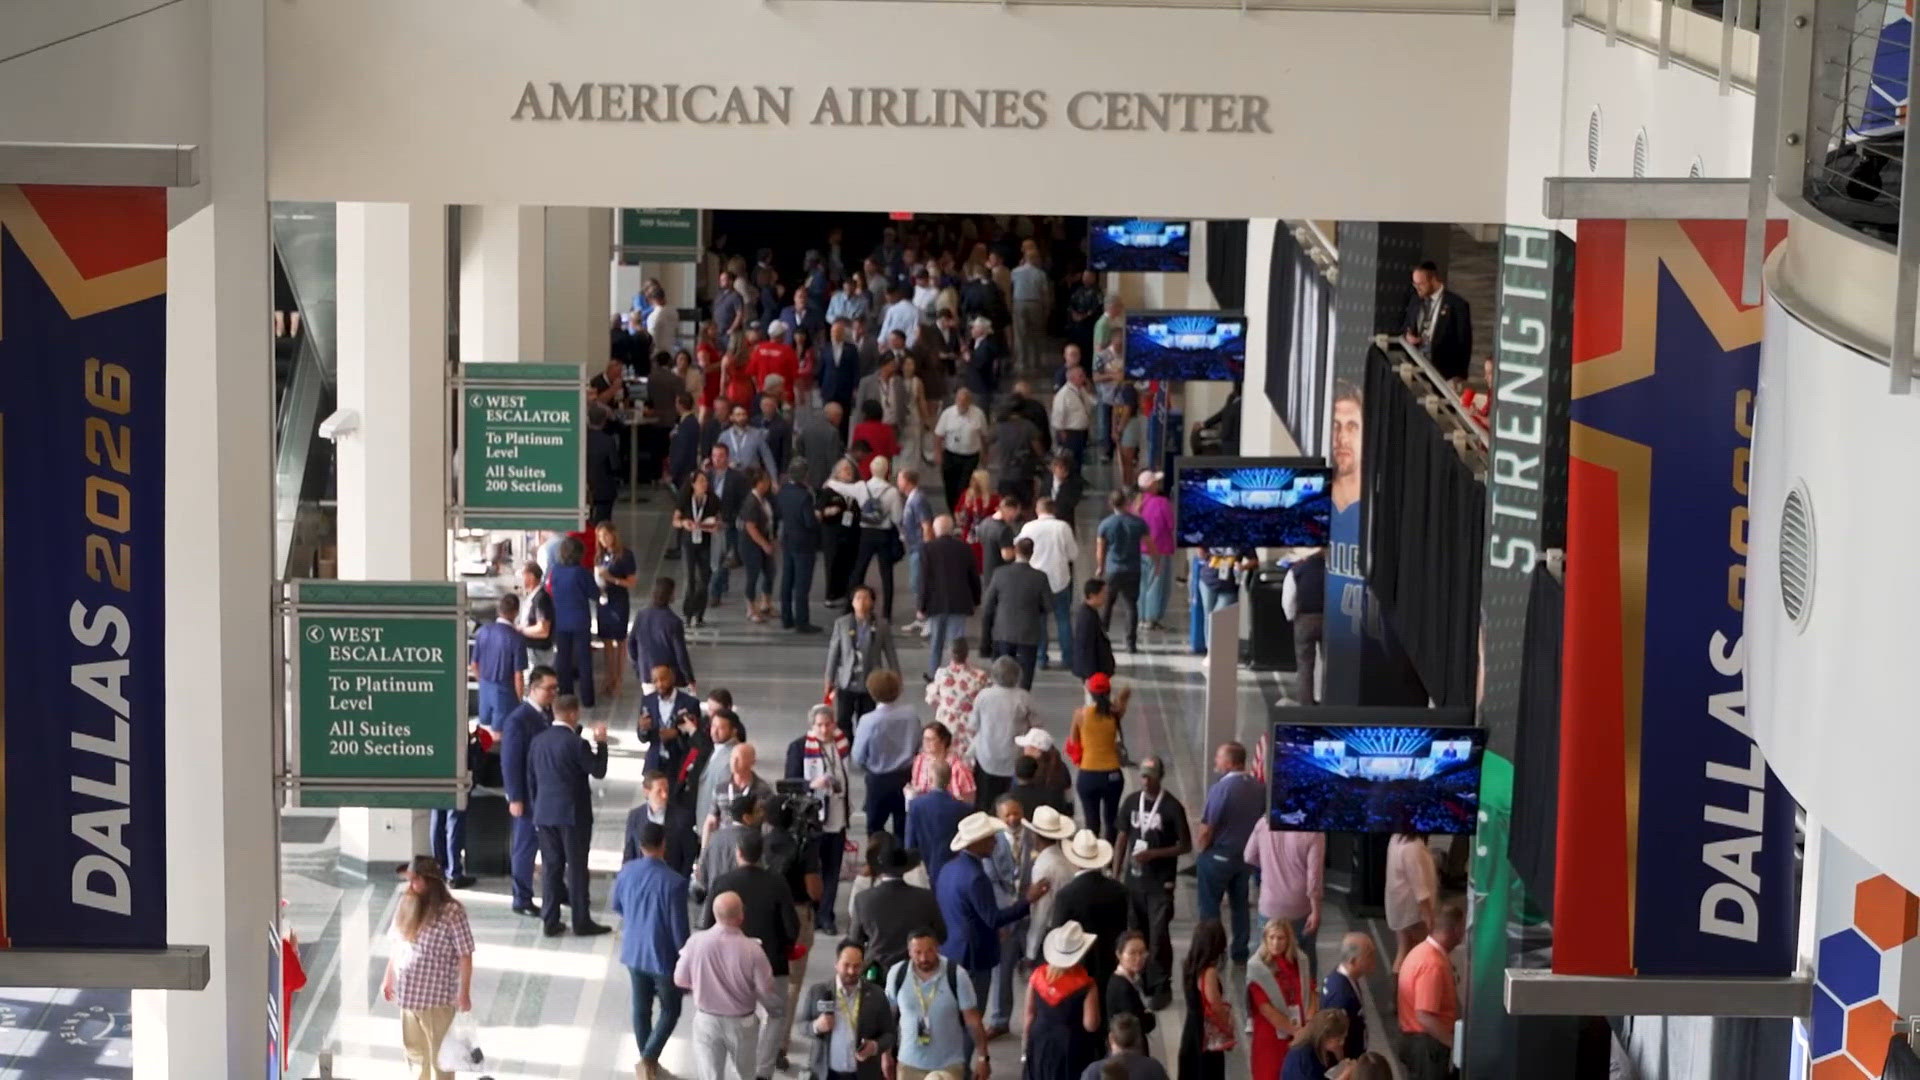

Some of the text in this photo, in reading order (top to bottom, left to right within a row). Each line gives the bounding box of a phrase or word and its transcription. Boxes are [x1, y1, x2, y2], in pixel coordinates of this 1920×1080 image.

[511, 81, 1274, 134] AMERICAN AIRLINES CENTER
[486, 395, 527, 409] WEST
[1489, 226, 1549, 575] STRENGTH
[486, 409, 571, 424] ESCALATOR
[485, 432, 564, 446] To Platinum
[486, 446, 519, 459] Level
[485, 465, 546, 479] All Suites
[485, 480, 563, 493] 200 Sections
[69, 357, 132, 916] DALLAS 2026
[329, 626, 384, 643] WEST
[329, 645, 444, 663] ESCALATOR
[328, 675, 434, 692] To Platinum
[329, 694, 373, 711] Level
[328, 719, 411, 737] All Suites
[329, 739, 435, 756] 200 Sections
